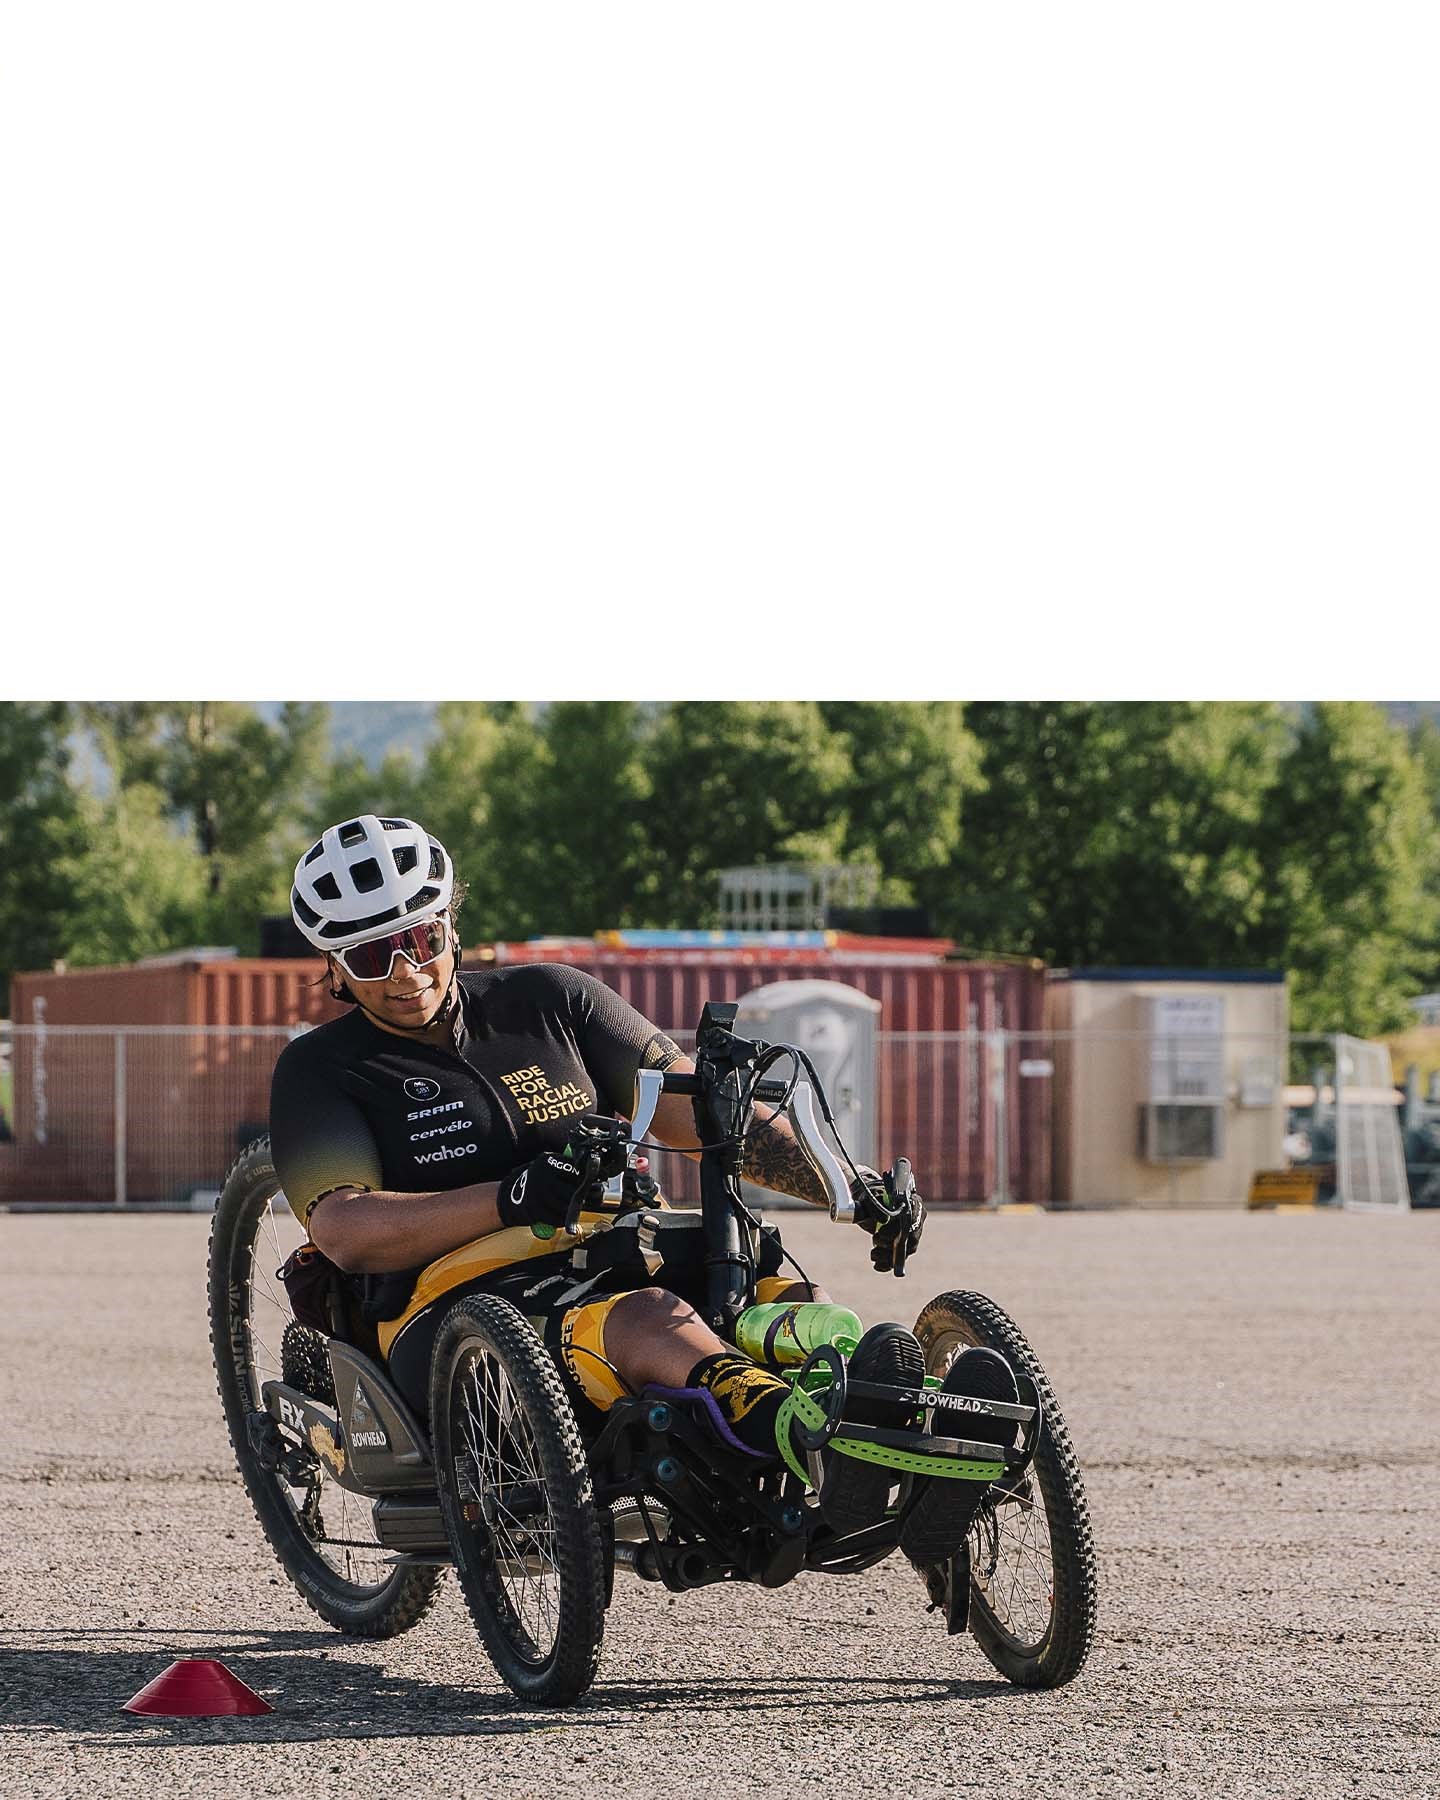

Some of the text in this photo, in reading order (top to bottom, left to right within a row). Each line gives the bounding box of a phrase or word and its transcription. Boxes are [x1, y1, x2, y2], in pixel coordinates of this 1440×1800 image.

[500, 1064, 545, 1086] RIDE
[509, 1077, 552, 1098] FOR
[516, 1081, 582, 1111] RACIAL
[407, 1100, 464, 1122] SRAM
[526, 1091, 593, 1125] JUSTICE
[410, 1120, 473, 1142] cervélo
[413, 1143, 478, 1165] wahoo
[547, 1156, 580, 1176] ERGON
[917, 1391, 981, 1413] BOWHEAD
[278, 1396, 308, 1436] RX
[351, 1431, 387, 1448] BOWHEAD
